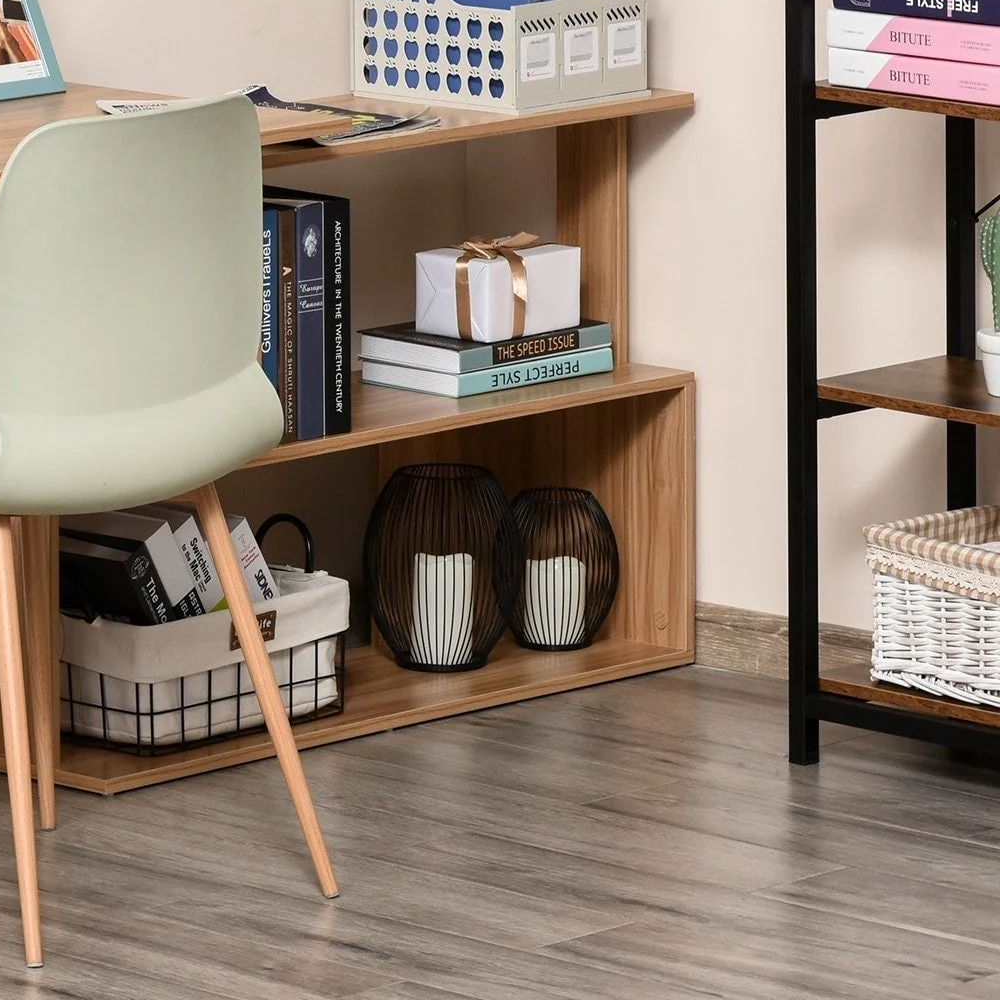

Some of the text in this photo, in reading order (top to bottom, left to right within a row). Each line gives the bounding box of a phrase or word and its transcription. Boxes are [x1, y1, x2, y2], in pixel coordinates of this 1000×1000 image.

[890, 30, 932, 46] BITUTE
[889, 69, 931, 86] BITUTE
[334, 220, 342, 284] ARCHITECTURE
[335, 288, 342, 299] IN
[287, 340, 293, 353] OF
[335, 323, 343, 371] TWENTIETH
[497, 333, 575, 361] THE SPEED ISSUE
[491, 360, 580, 388] PERFECT SYLE
[335, 372, 343, 413] CENTURY
[189, 559, 201, 581] Mac
[190, 537, 212, 584] Switching
[146, 577, 159, 603] The
